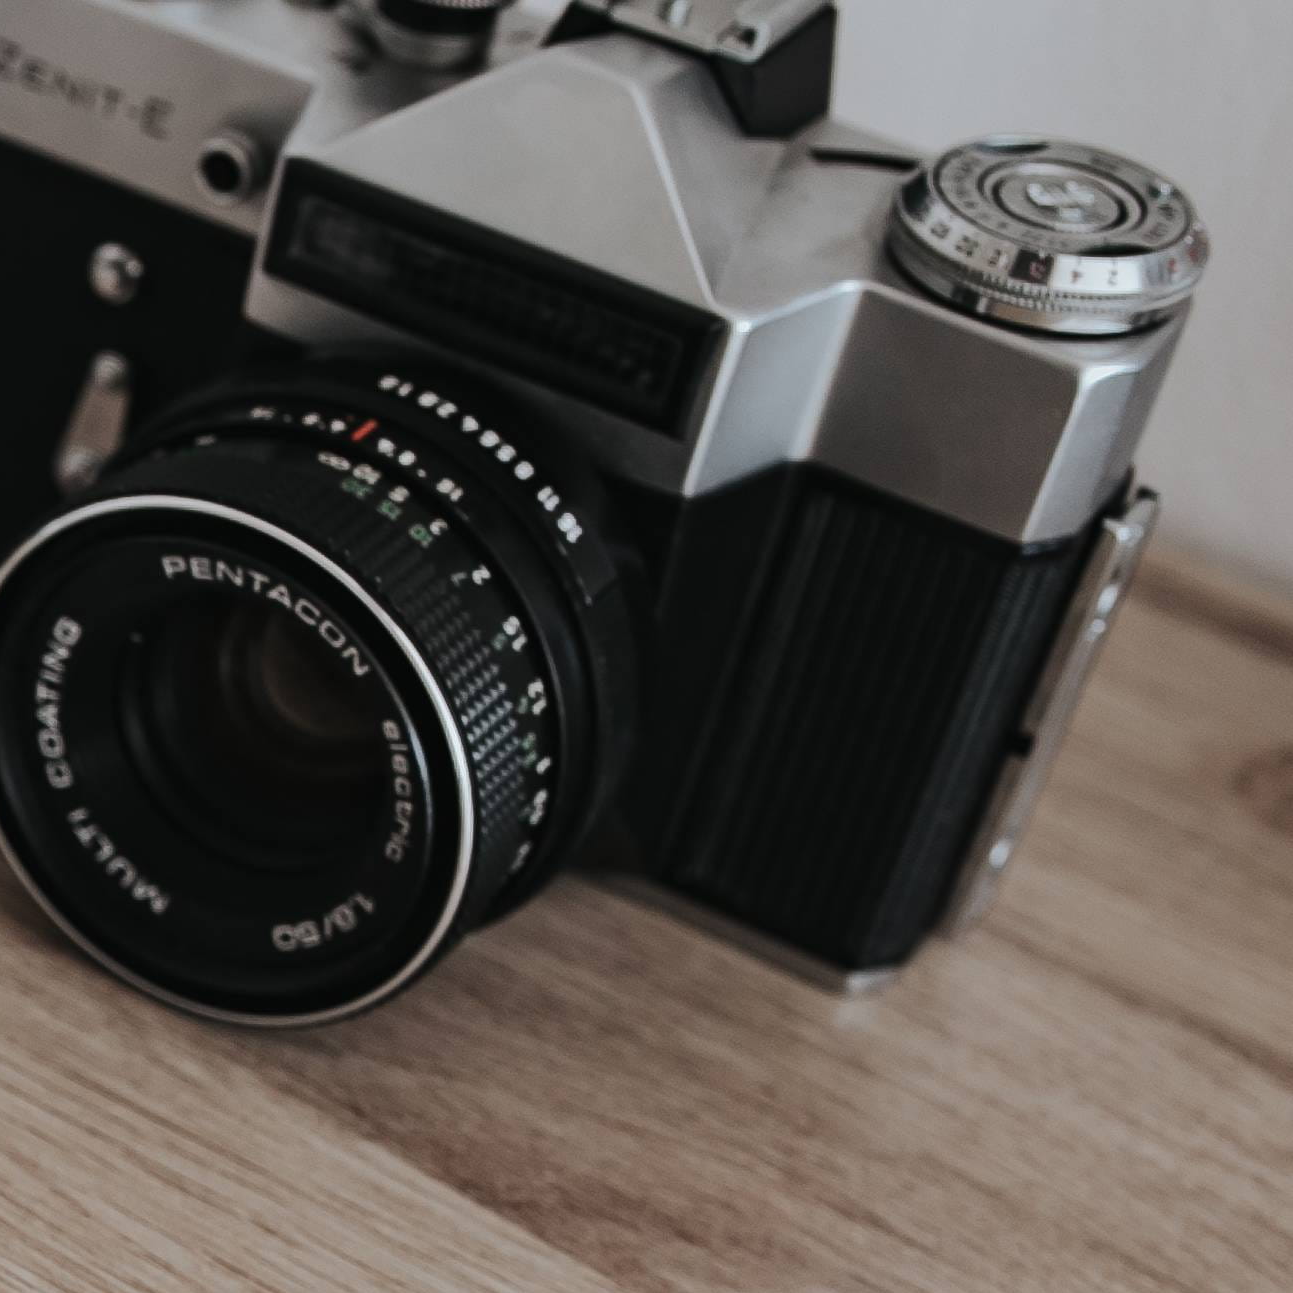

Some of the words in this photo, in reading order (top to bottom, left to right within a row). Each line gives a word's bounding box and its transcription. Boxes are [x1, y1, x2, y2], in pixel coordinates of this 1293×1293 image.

[160, 555, 371, 678] PENTACON
[34, 614, 83, 791] COATING
[381, 718, 415, 864] electric
[67, 806, 170, 915] MULTI
